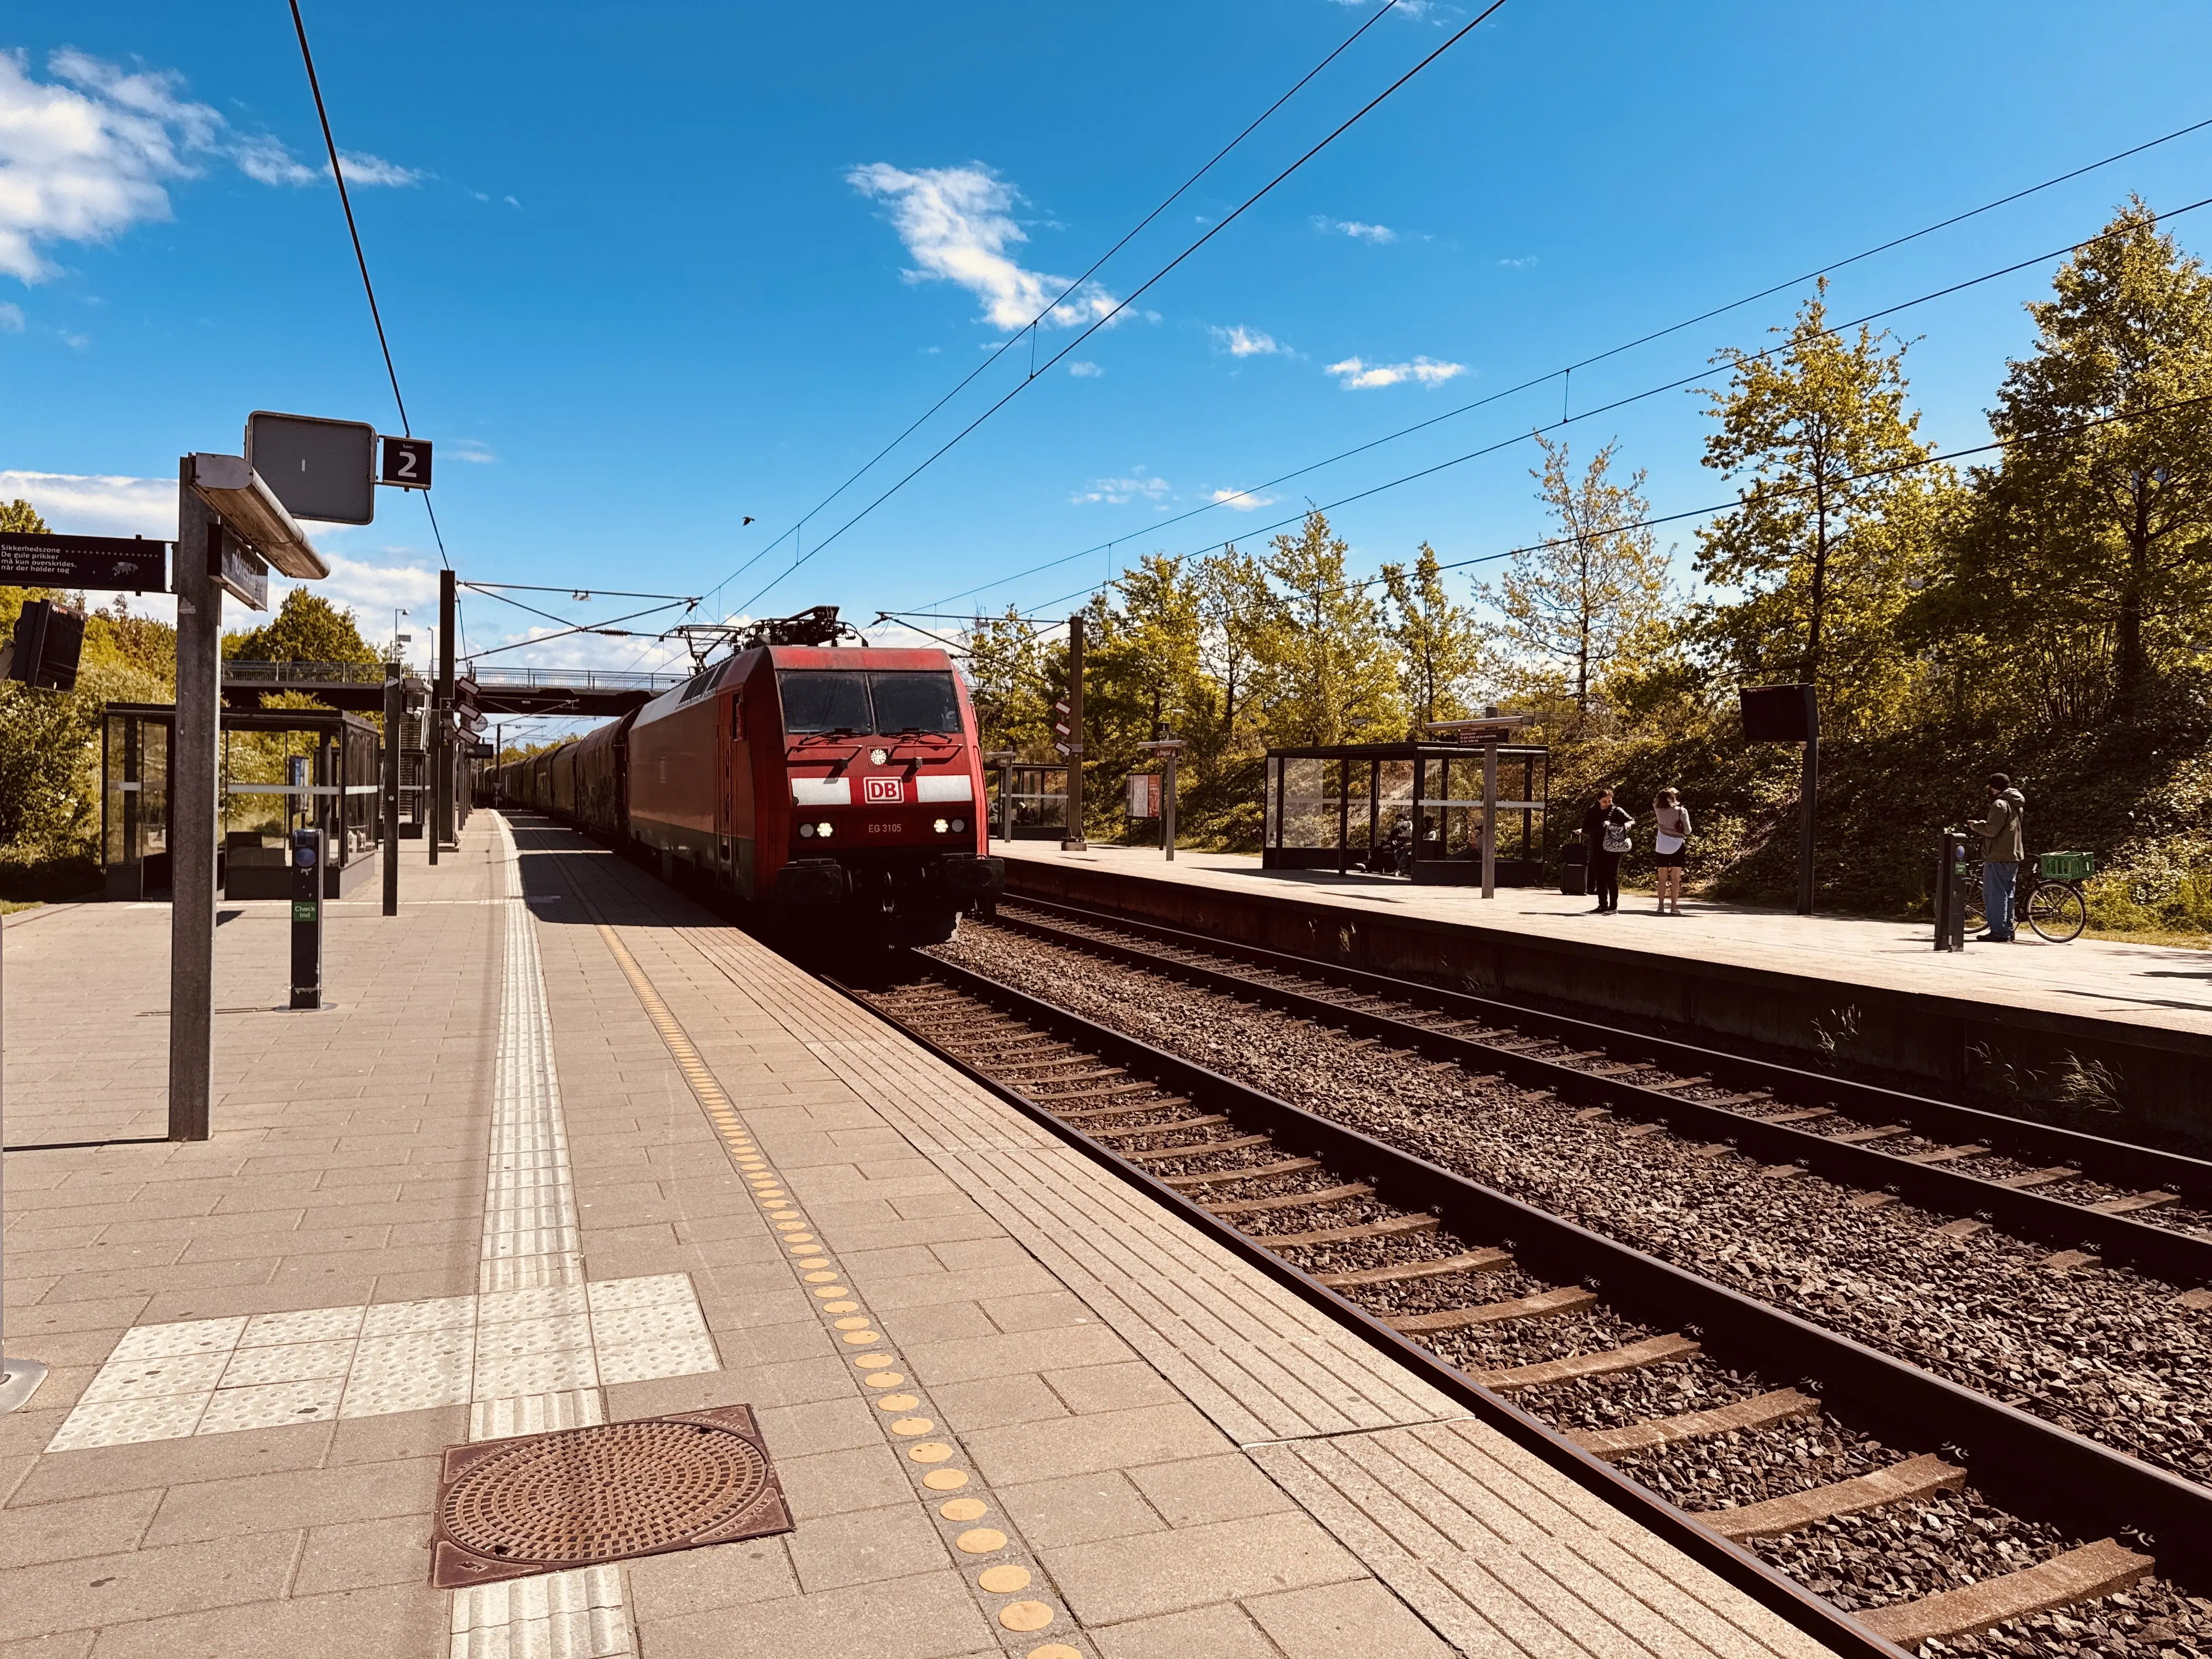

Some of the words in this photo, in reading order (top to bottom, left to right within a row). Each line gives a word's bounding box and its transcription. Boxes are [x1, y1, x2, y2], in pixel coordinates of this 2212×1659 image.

[398, 452, 417, 478] 2
[1, 544, 61, 554] Sikkerhedszone
[871, 782, 897, 798] DB
[868, 825, 880, 833] EG
[882, 823, 902, 832] 3105
